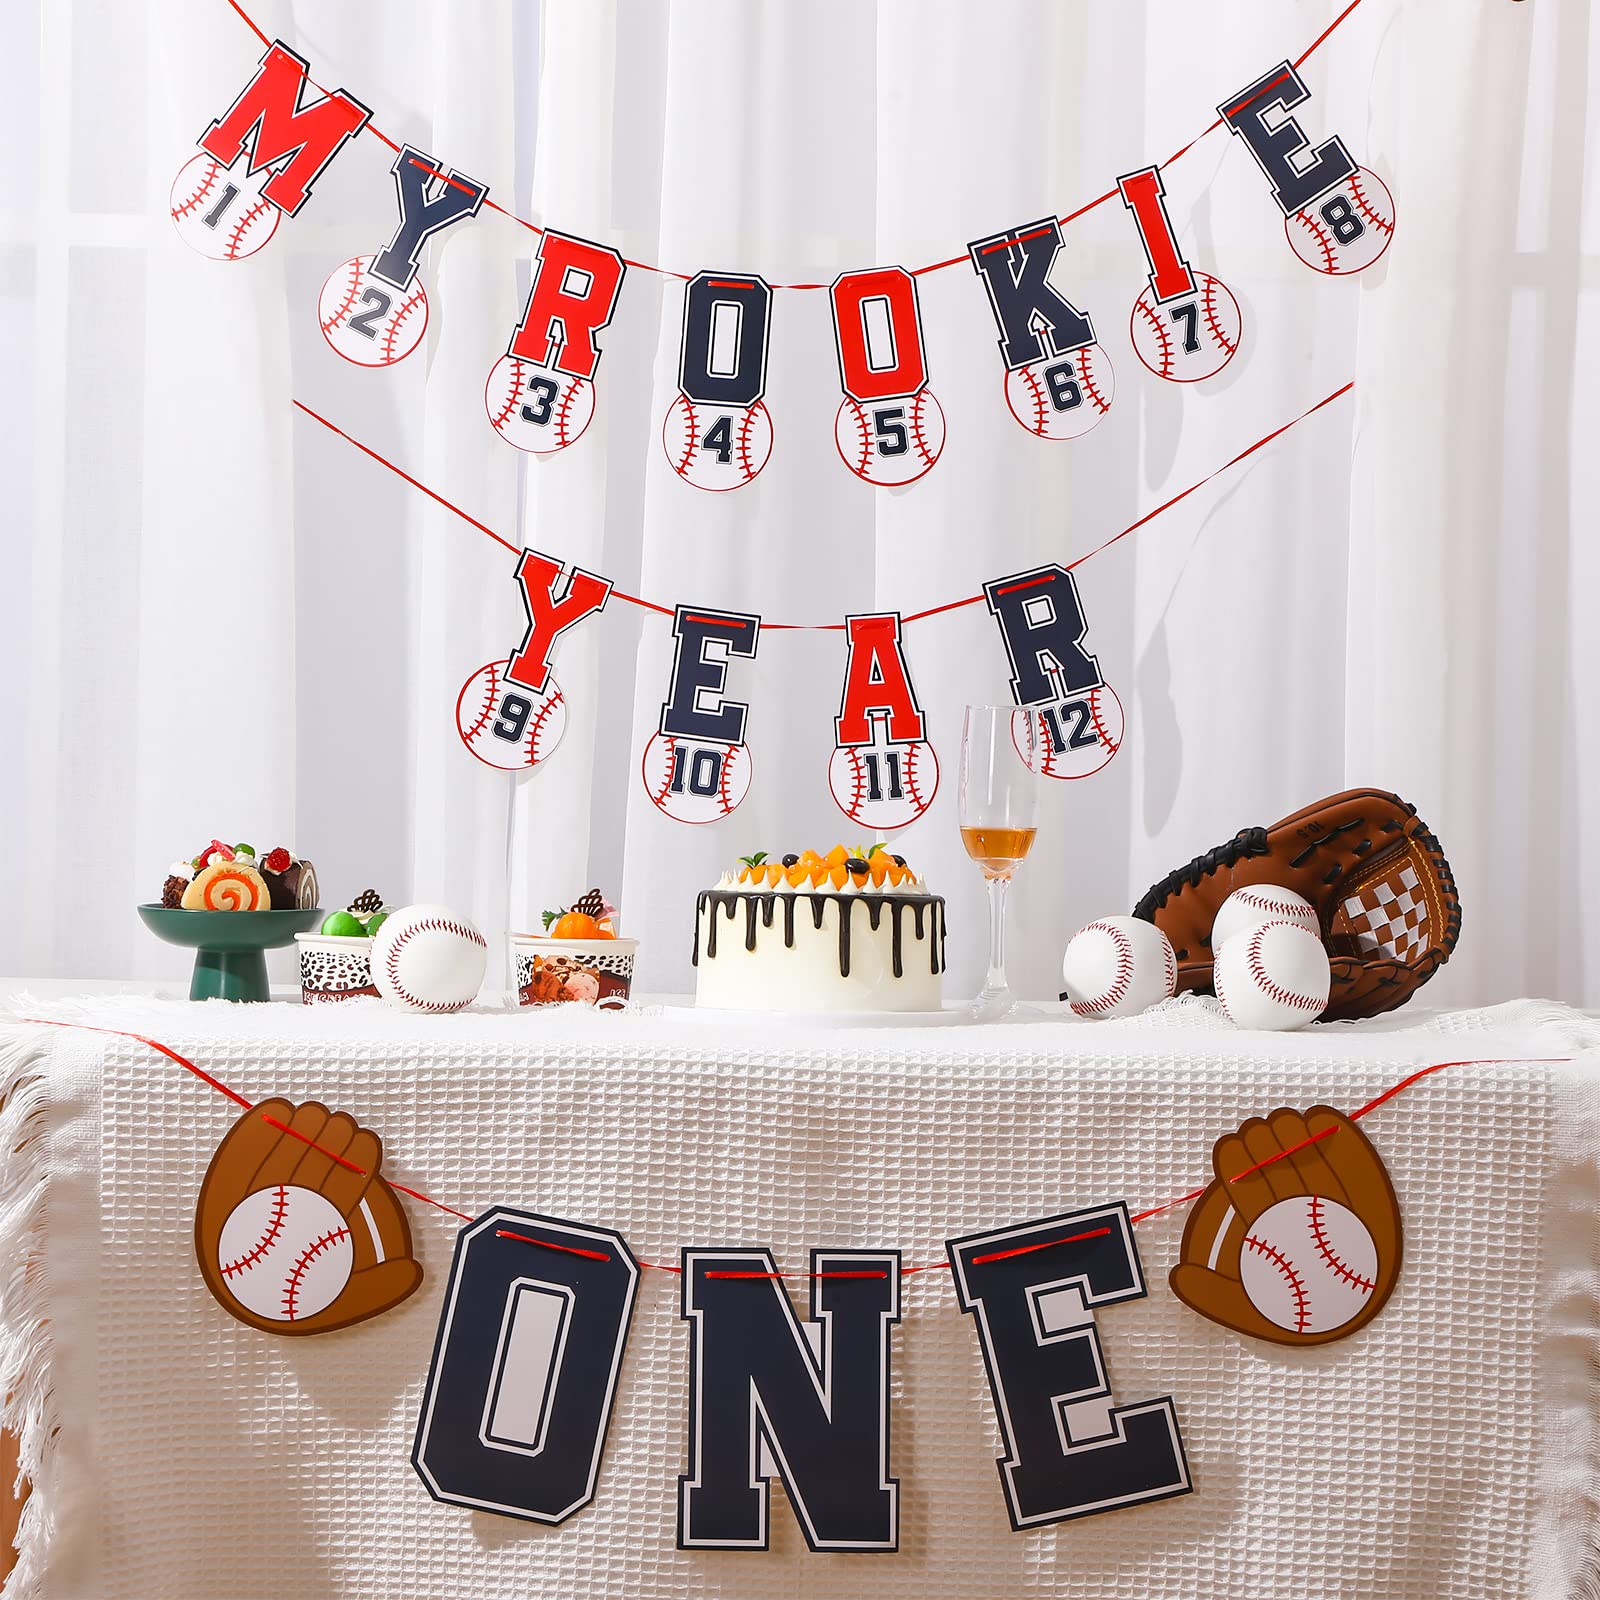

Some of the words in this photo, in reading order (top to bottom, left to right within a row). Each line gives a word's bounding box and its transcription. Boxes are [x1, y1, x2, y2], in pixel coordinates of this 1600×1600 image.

[196, 39, 490, 291] MY
[507, 59, 1360, 407] ROOKIE
[200, 181, 242, 231] 1
[1317, 193, 1366, 247] 8
[345, 285, 395, 341] 2
[1169, 300, 1203, 355] 7
[519, 374, 562, 427] 3
[1041, 359, 1084, 414] 6
[699, 414, 735, 465] 4
[872, 405, 911, 458] 5
[503, 547, 1104, 748] YEAR
[489, 692, 535, 744] 9
[1040, 698, 1100, 756] 12
[669, 746, 723, 798] 10
[864, 751, 907, 803] 11
[411, 1200, 1193, 1552] ONE
